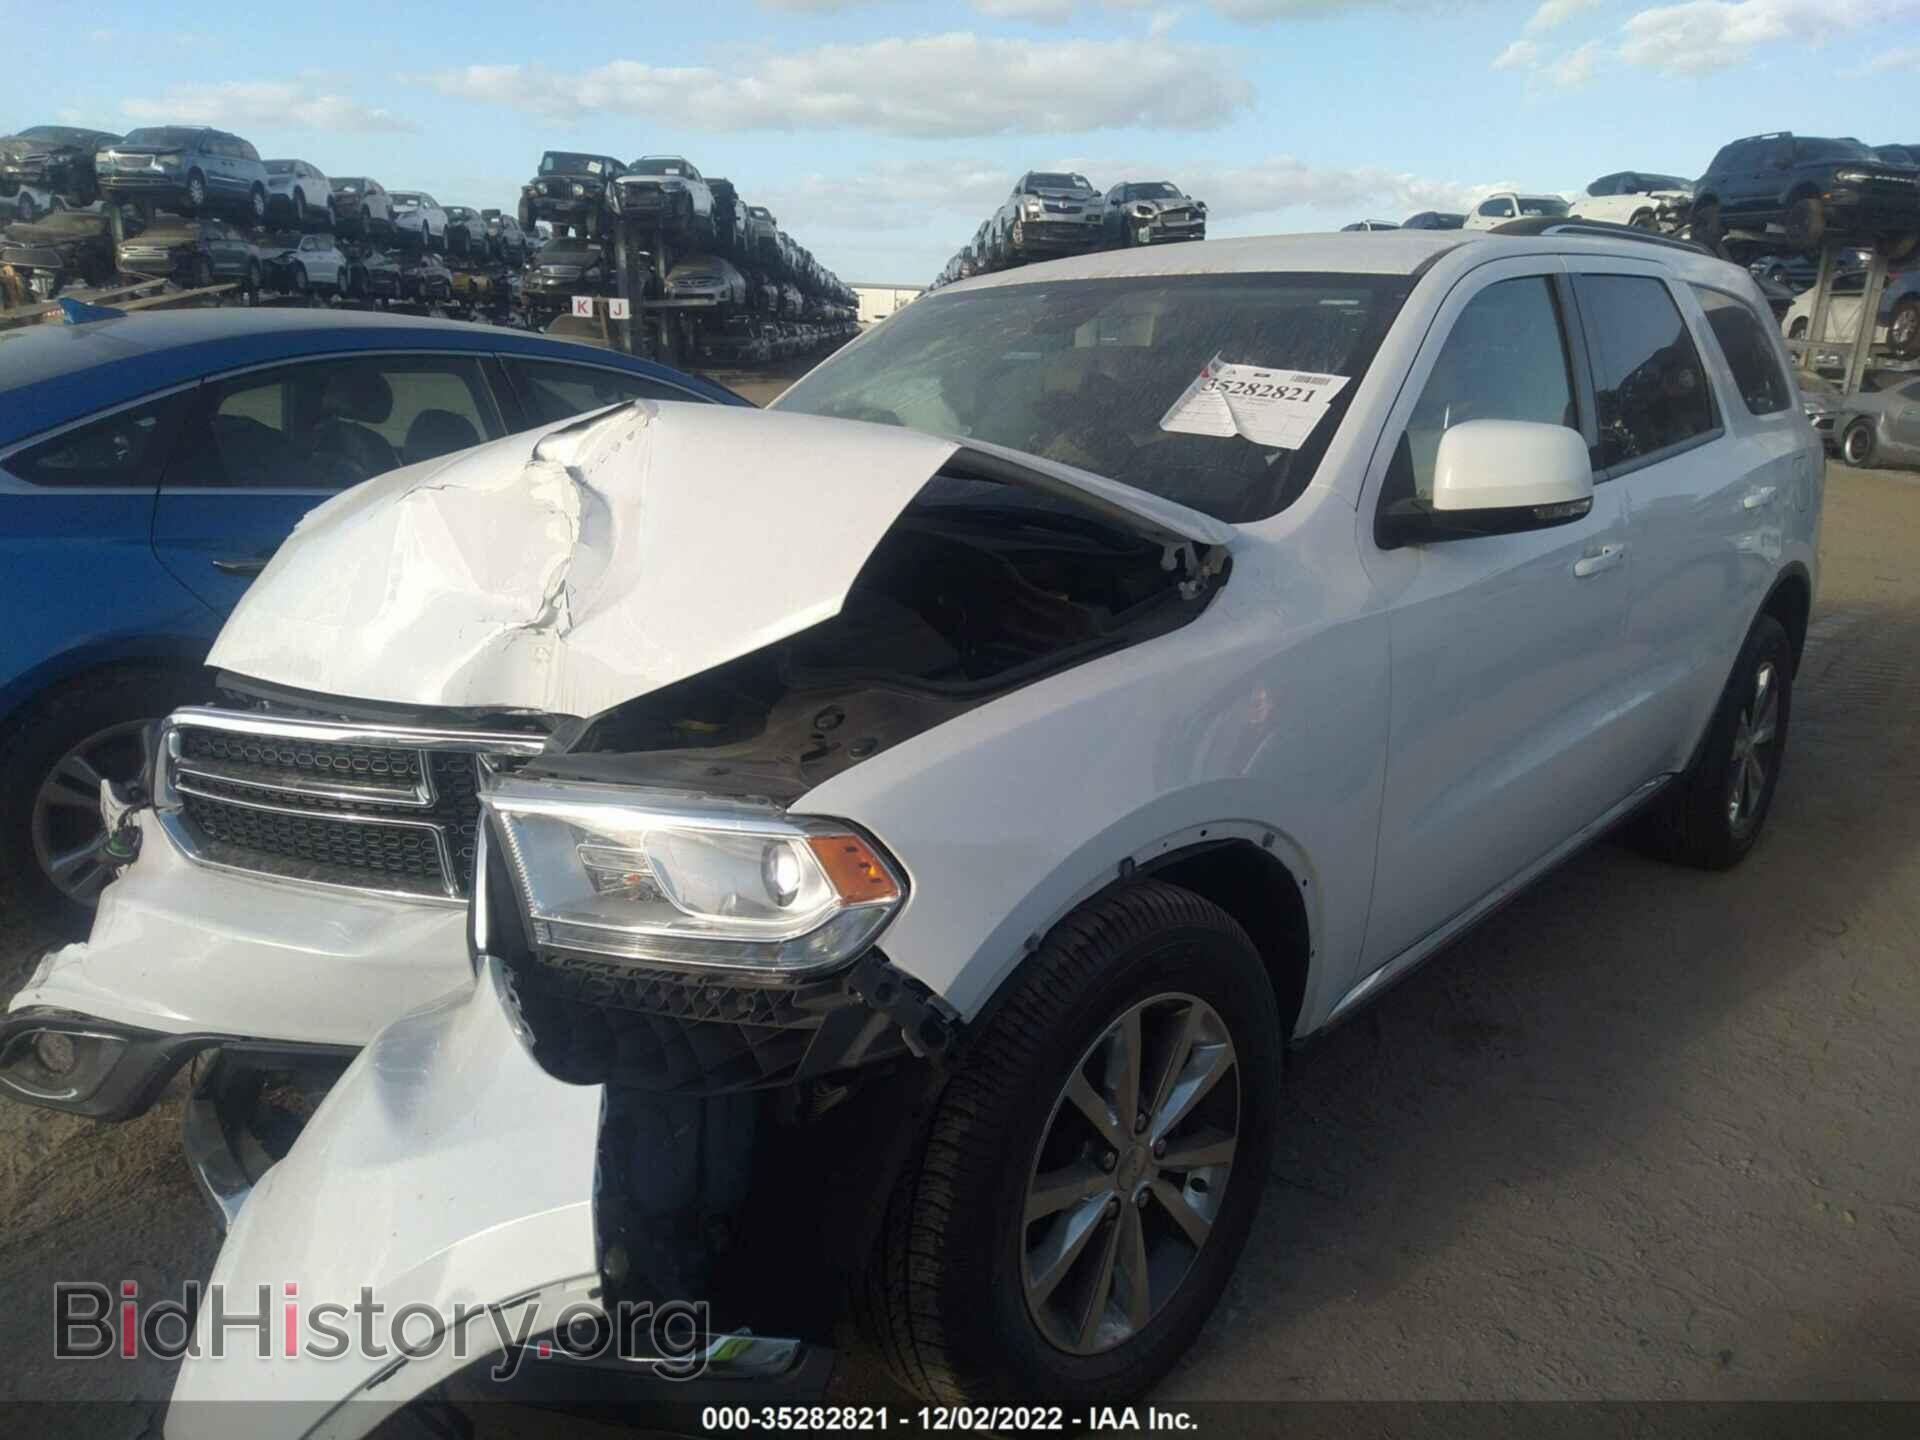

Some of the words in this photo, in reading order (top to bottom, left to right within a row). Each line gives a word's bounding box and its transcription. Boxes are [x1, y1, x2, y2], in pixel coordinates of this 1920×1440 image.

[577, 300, 589, 314] K
[613, 302, 623, 316] J
[1201, 378, 1316, 402] 35282821
